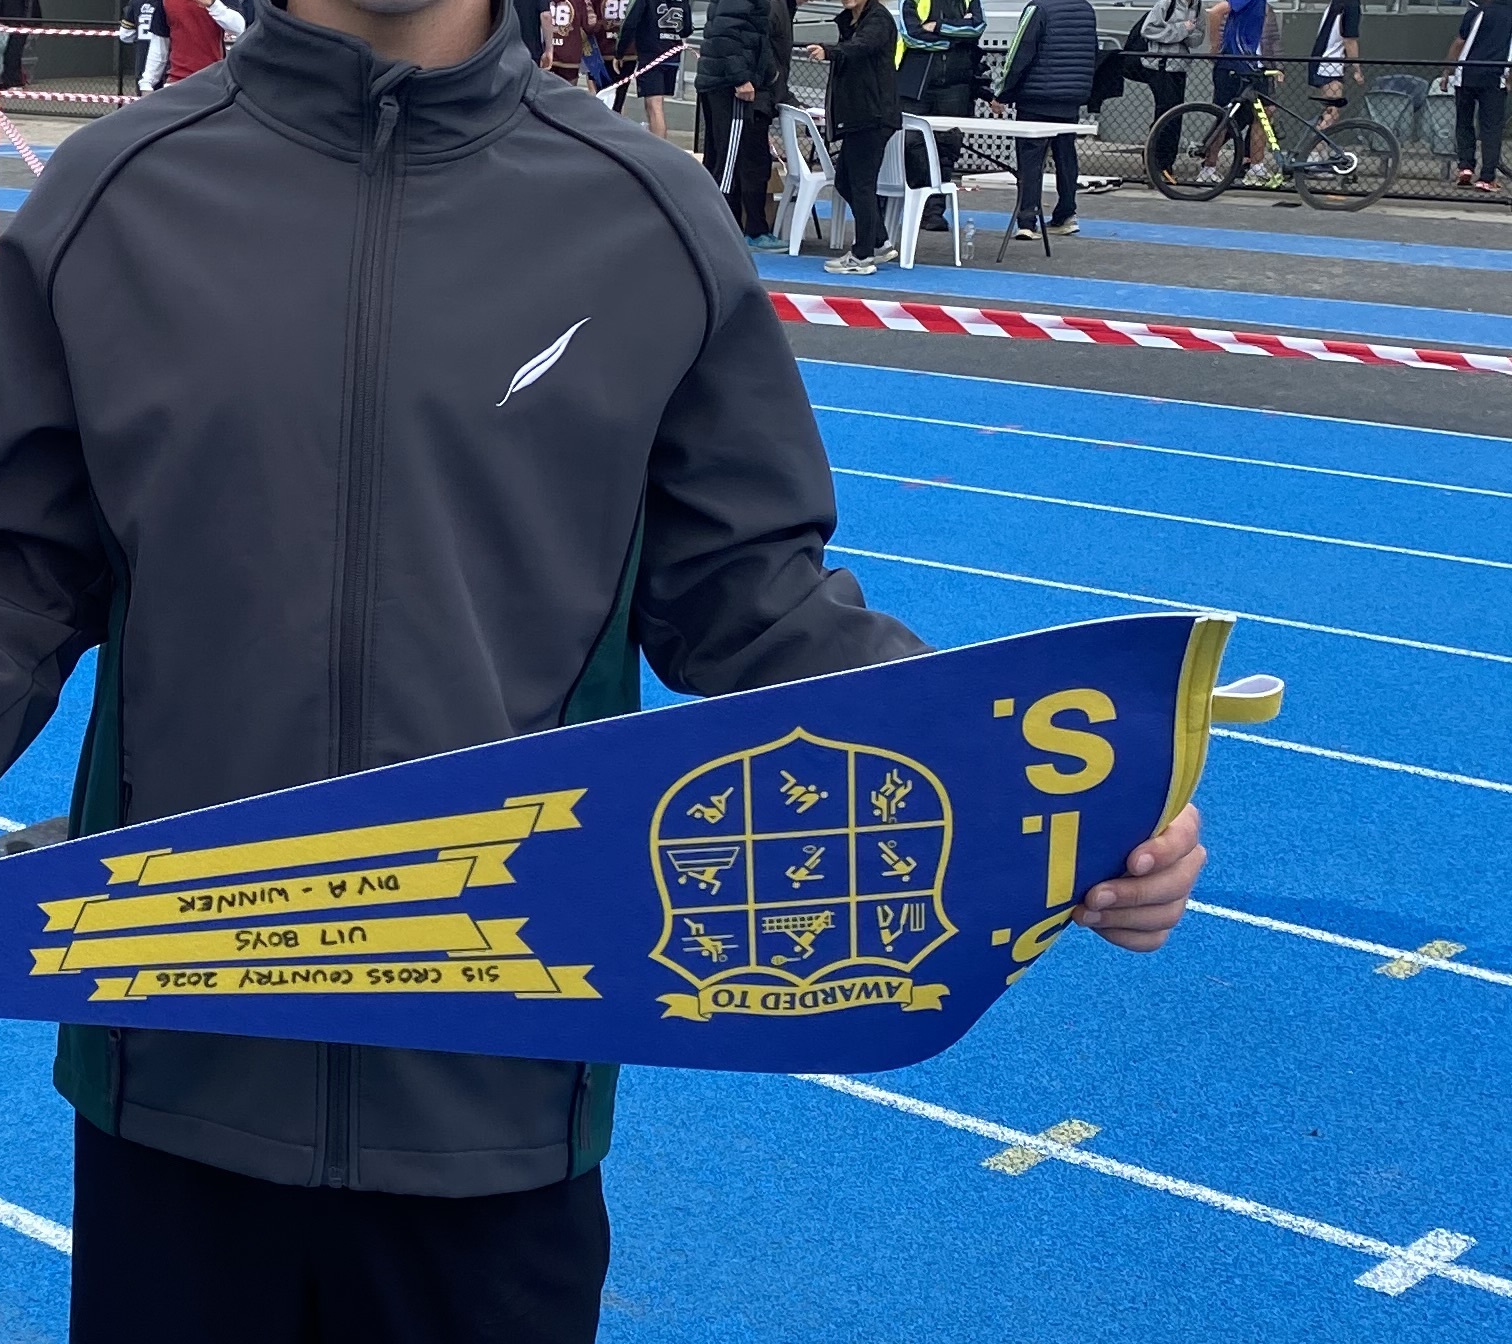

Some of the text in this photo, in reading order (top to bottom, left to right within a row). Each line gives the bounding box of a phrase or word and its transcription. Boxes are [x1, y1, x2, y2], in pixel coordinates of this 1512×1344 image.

[328, 879, 347, 899] A
[356, 873, 401, 896] DIV
[177, 885, 290, 915] WINNER
[234, 925, 368, 952] U17 BOYS
[155, 965, 501, 989] SIS CROSS COUNTRY 2026
[711, 980, 903, 1011] AWARDED TO
